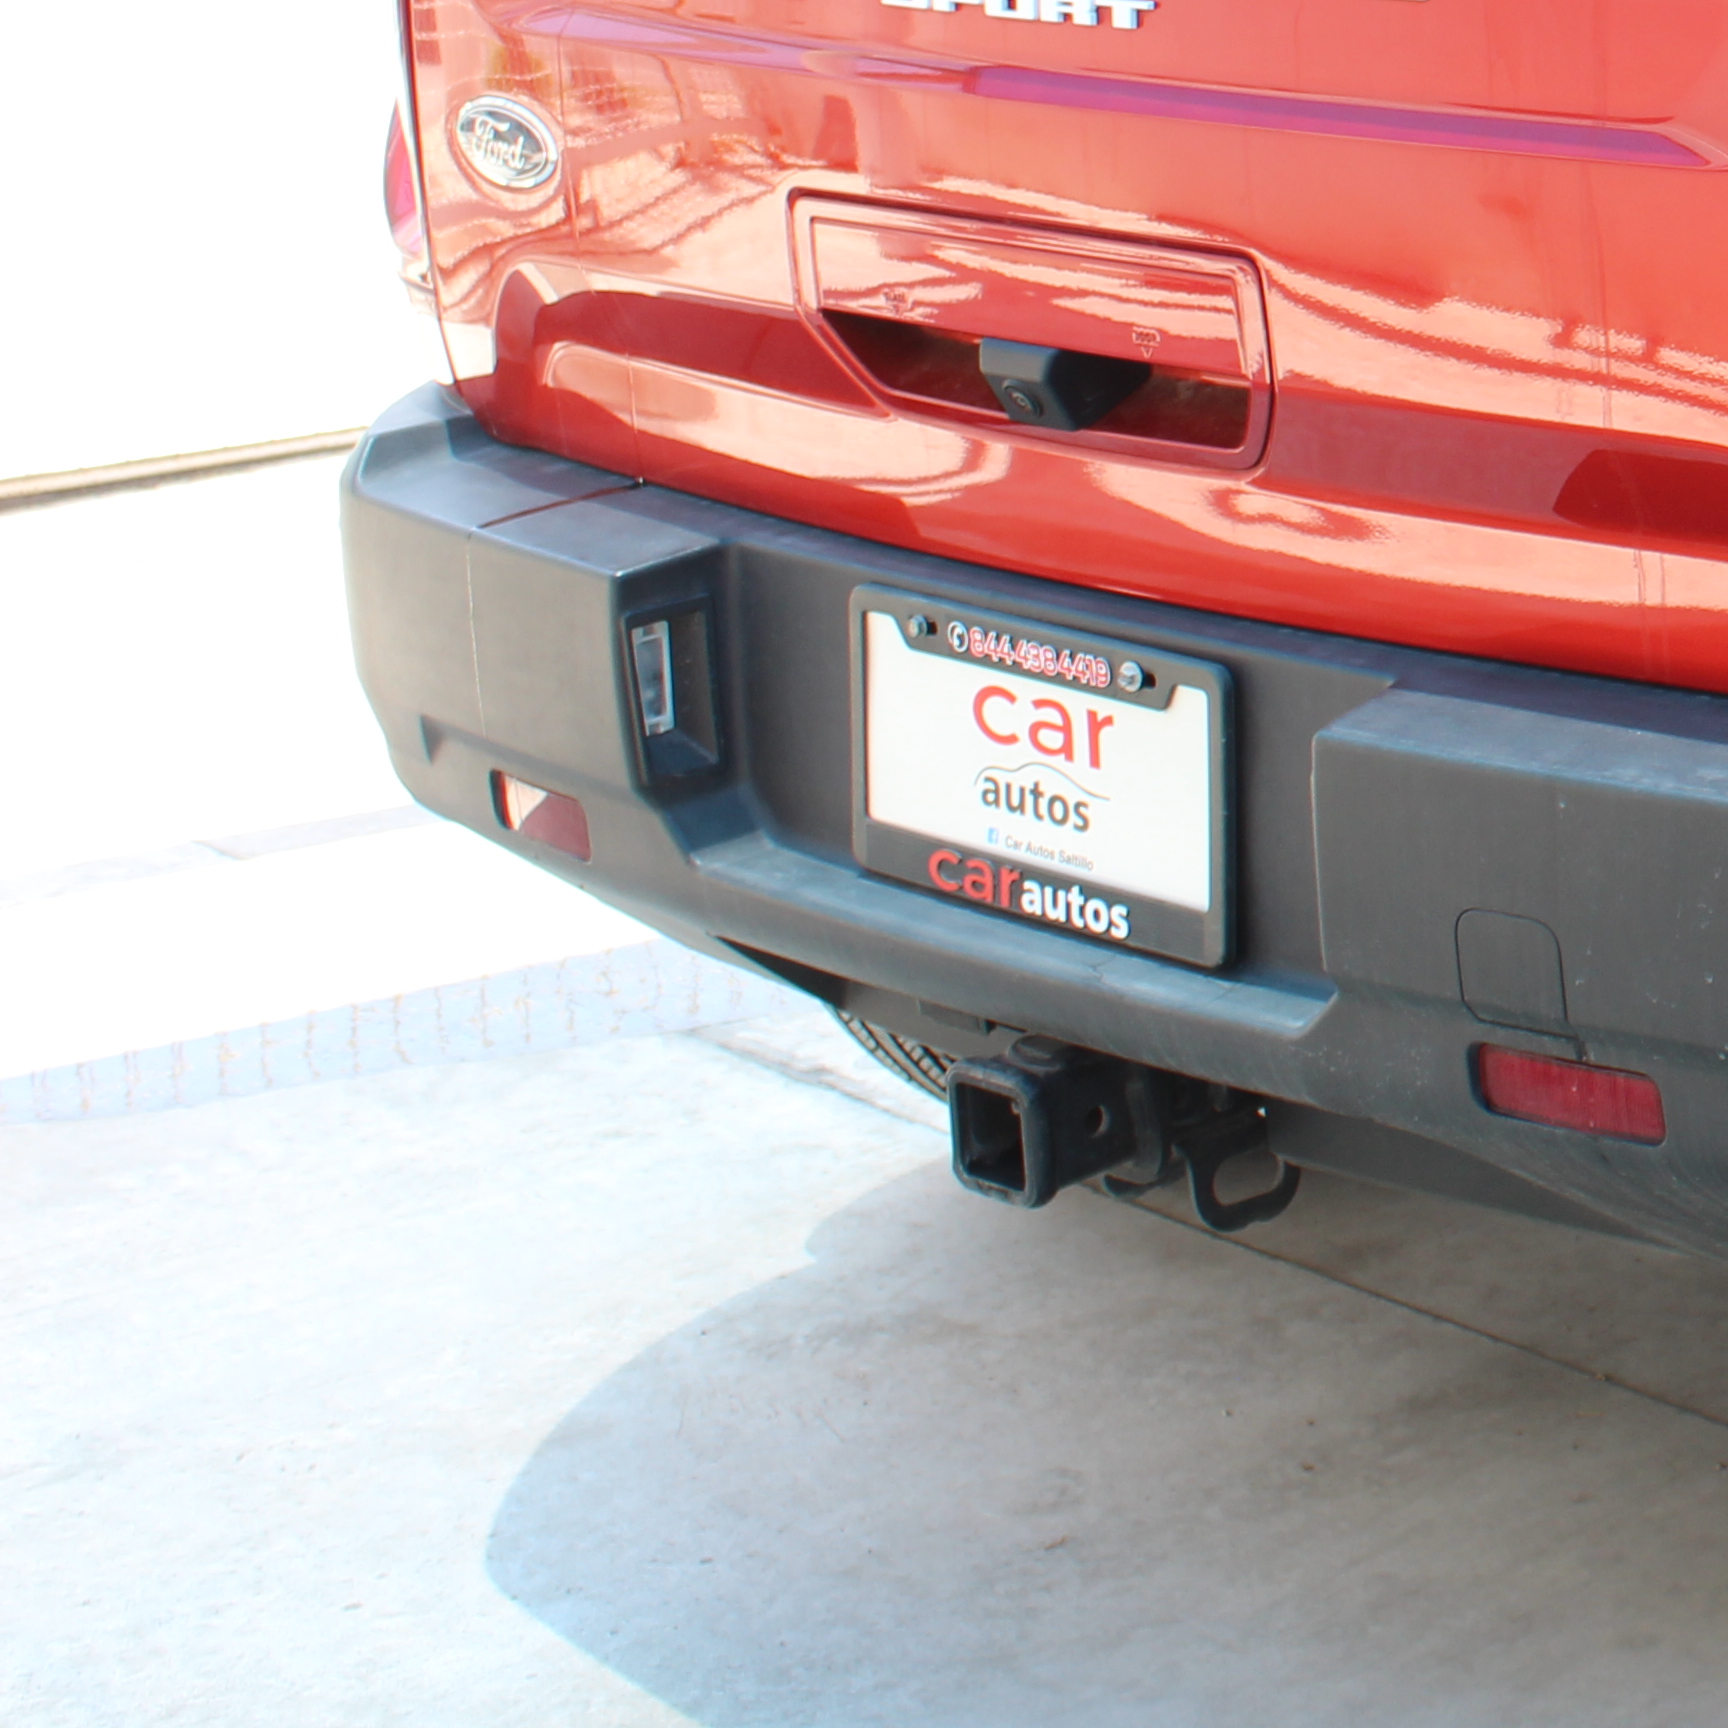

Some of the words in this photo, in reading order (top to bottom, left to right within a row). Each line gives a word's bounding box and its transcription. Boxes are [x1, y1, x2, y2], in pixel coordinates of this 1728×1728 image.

[469, 113, 526, 171] Ford
[969, 625, 1014, 666] 844
[1014, 638, 1058, 677] 438
[1057, 649, 1112, 689] 4419
[972, 684, 1114, 771] car
[981, 774, 1091, 833] autos
[1004, 834, 1023, 850] Car
[1024, 840, 1056, 861] Autos
[1057, 848, 1095, 872] Saltillo
